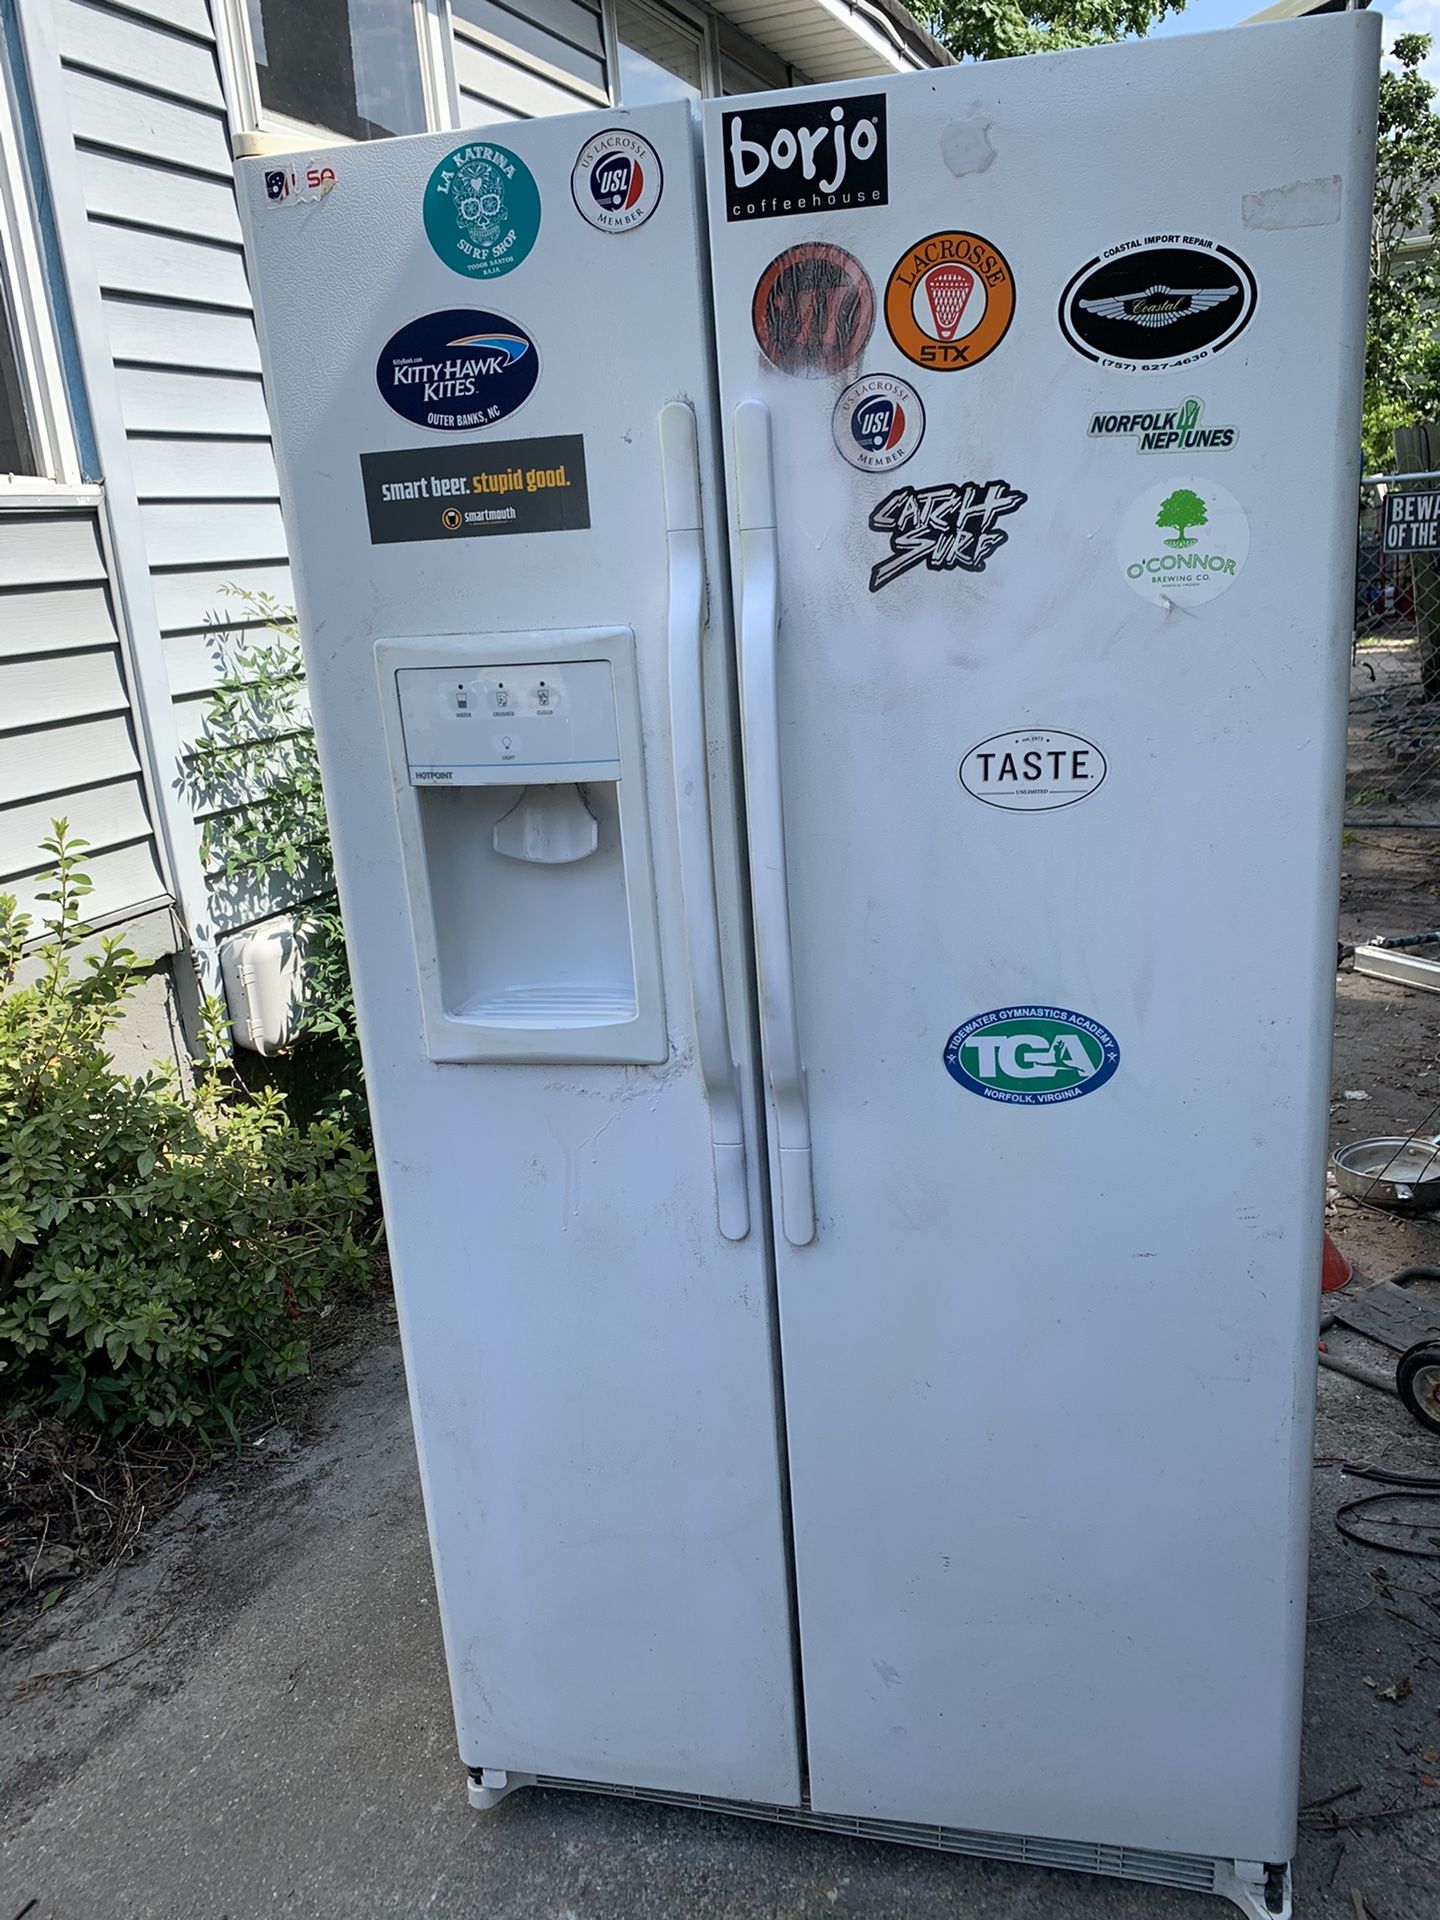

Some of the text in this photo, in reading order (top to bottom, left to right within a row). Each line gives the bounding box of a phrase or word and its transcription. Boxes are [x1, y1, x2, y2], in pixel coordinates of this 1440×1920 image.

[582, 137, 648, 168] US LACROSSE
[437, 146, 517, 194] LA KATRINA
[600, 168, 628, 194] USL
[732, 190, 881, 215] coffeehouse
[597, 208, 644, 226] MEMBER
[457, 229, 517, 259] SURF SHOP
[1103, 235, 1213, 258] COASTAL IMPORT REPAIR
[467, 256, 514, 270] TODOS SANTOS
[896, 239, 1006, 289] LACROSSE
[1132, 296, 1186, 314] Coastal
[920, 345, 970, 362] STX
[1102, 351, 1208, 372] (757) 627-4630
[393, 356, 503, 385] KITTY HAWK
[423, 378, 477, 402] KITES
[843, 381, 910, 411] US LACROSSE
[427, 404, 500, 427] OUTER BANKS, NC
[861, 411, 890, 435] USL
[1091, 412, 1178, 433] NORFOLK
[1141, 418, 1234, 450] NEPTUNES
[857, 449, 905, 466] MEMBER
[381, 465, 571, 501] smart beer. stupid good.
[464, 507, 516, 523] smartmouth
[872, 483, 1024, 533] CATCH
[1388, 522, 1438, 548] OF THE
[873, 528, 1004, 587] SURF
[1126, 553, 1236, 580] O'CONNOR
[1152, 574, 1192, 583] BREWING
[415, 772, 453, 780] HOTPOINT
[976, 750, 1094, 782] TASTE.
[948, 1008, 1115, 1050] TIDEWATER GYMNASTICS ACADEMY
[965, 1034, 1097, 1079] TGA
[984, 1087, 1083, 1104] NORFOLK, VIRGINIA
